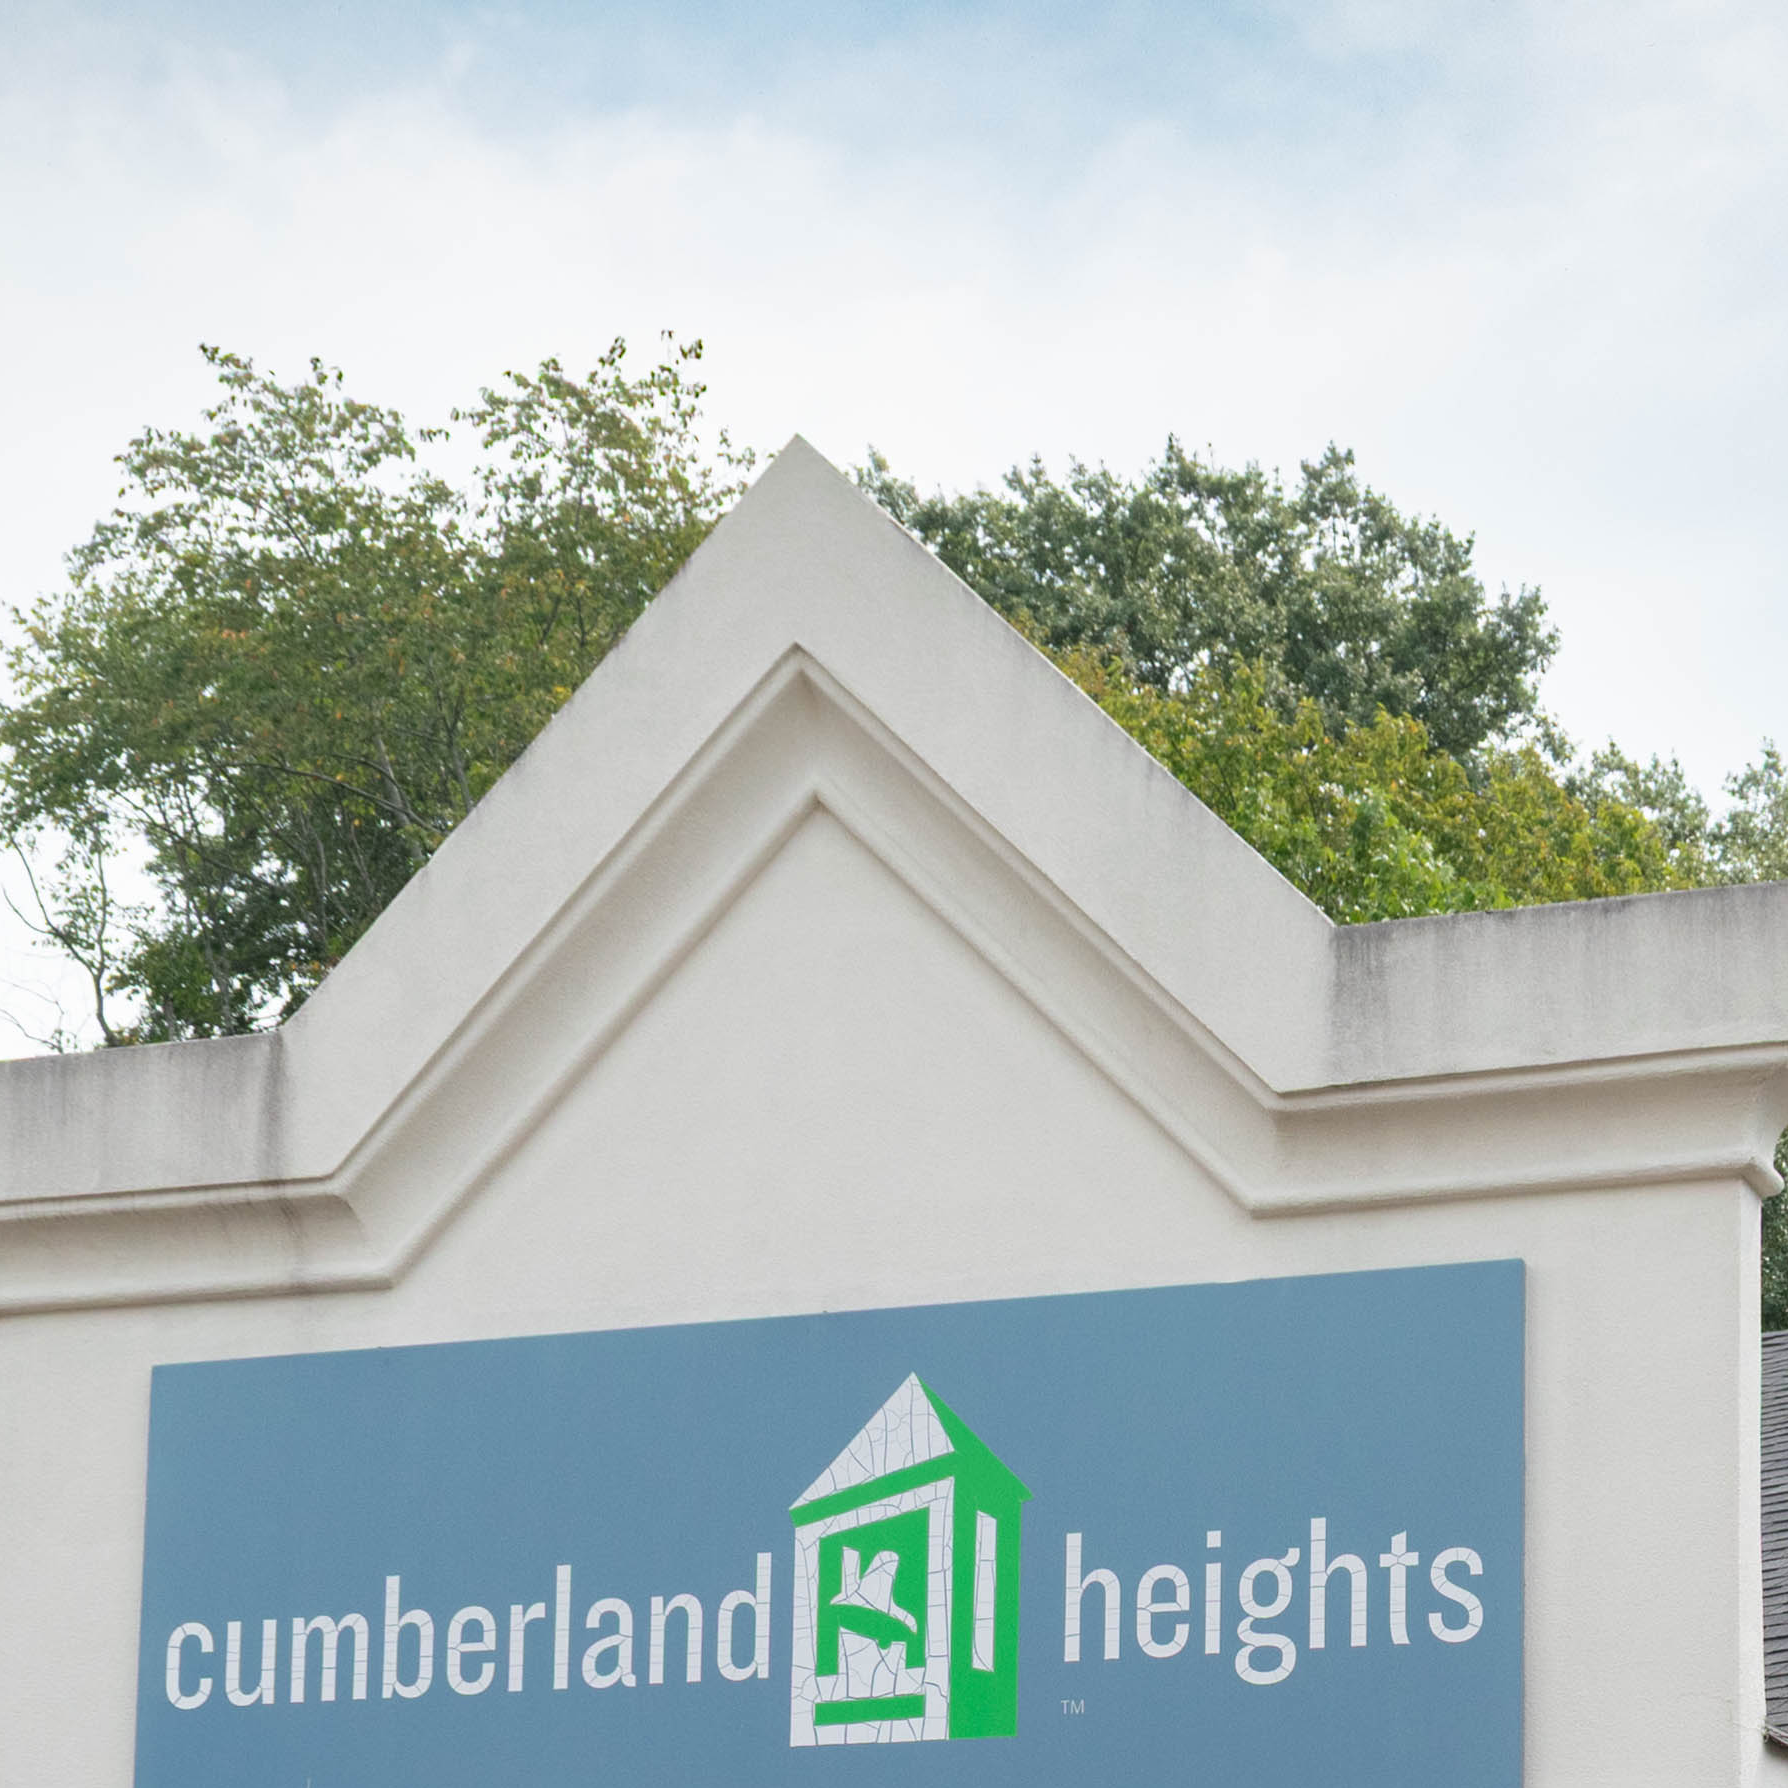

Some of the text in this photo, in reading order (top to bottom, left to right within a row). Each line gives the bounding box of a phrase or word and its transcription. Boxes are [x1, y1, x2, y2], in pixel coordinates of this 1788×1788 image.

[164, 1517, 1485, 1710] cumberland heights
[1060, 1699, 1085, 1715] TM
